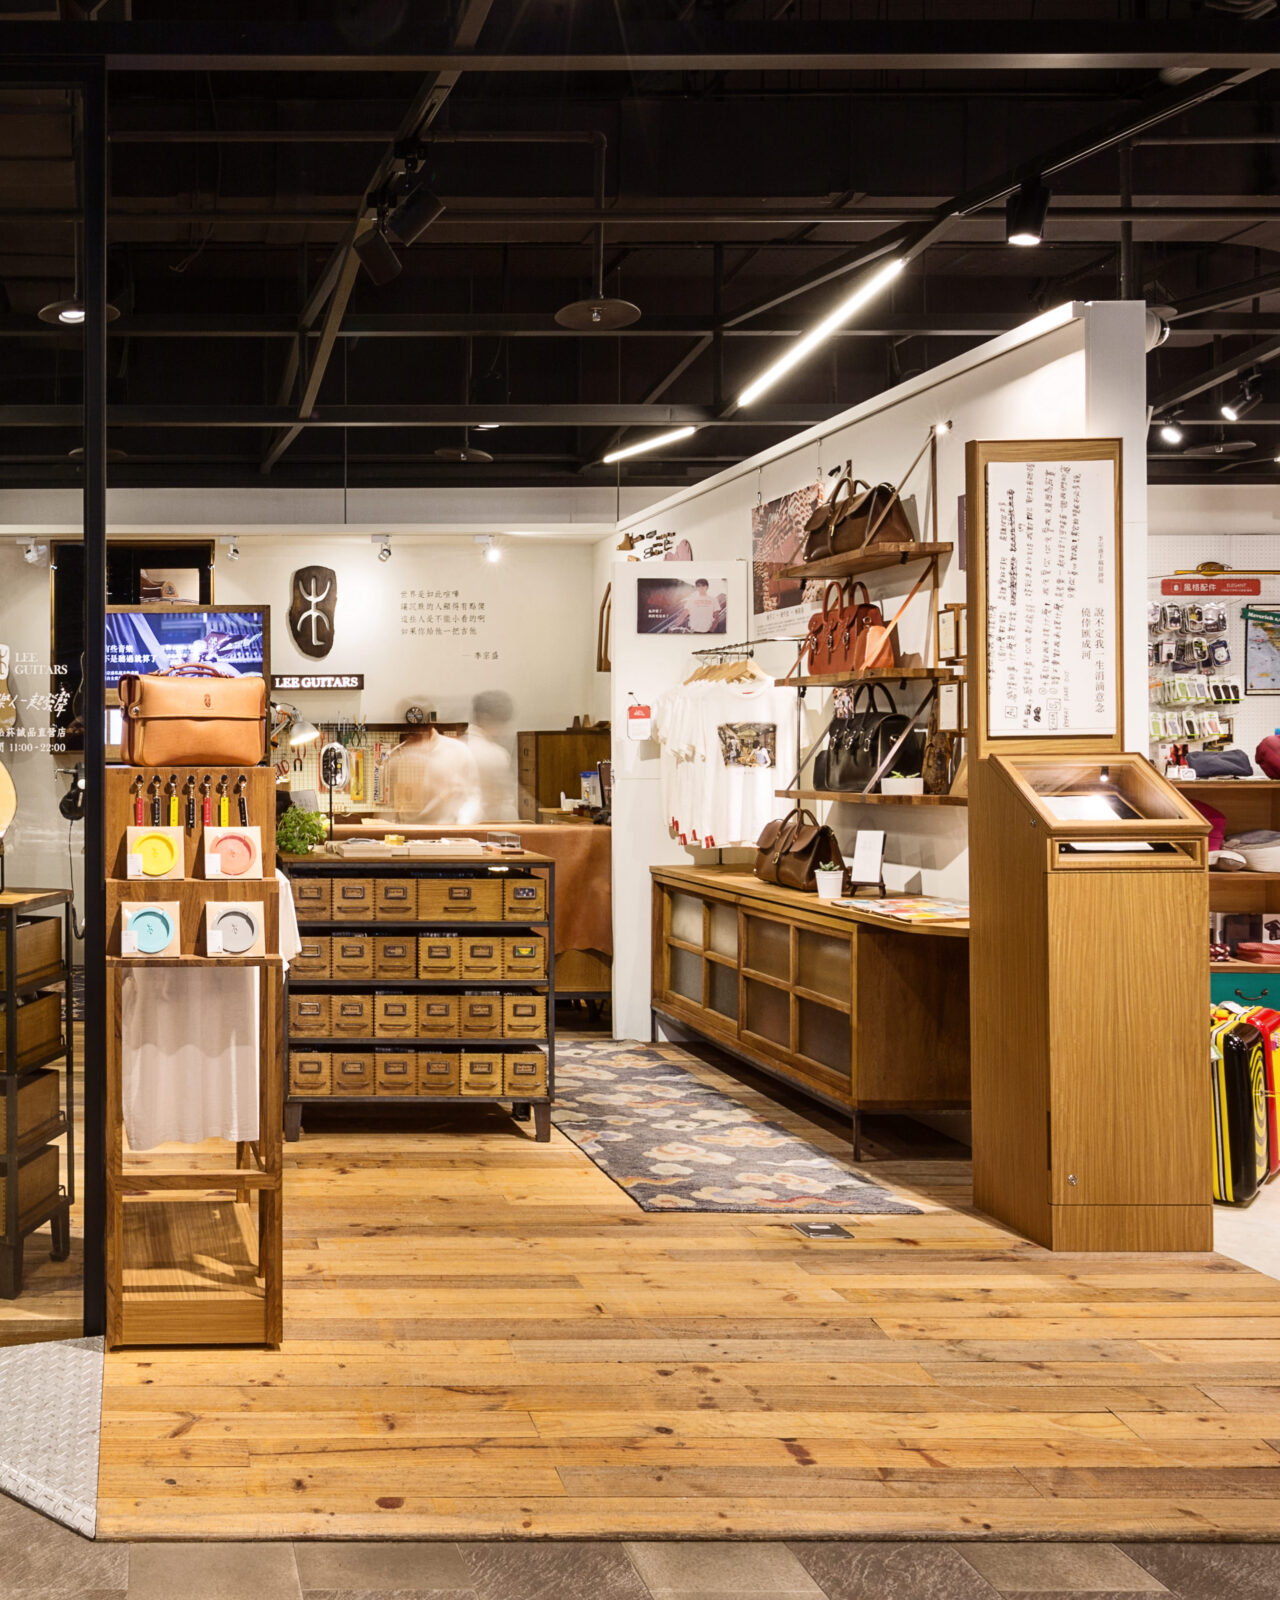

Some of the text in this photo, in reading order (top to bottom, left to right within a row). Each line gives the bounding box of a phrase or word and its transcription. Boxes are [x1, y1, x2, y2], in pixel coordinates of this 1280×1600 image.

[1183, 583, 1216, 592] 風格配件
[14, 652, 38, 663] LEE
[14, 664, 68, 675] GUITARS
[275, 676, 359, 688] LEE GUITARS
